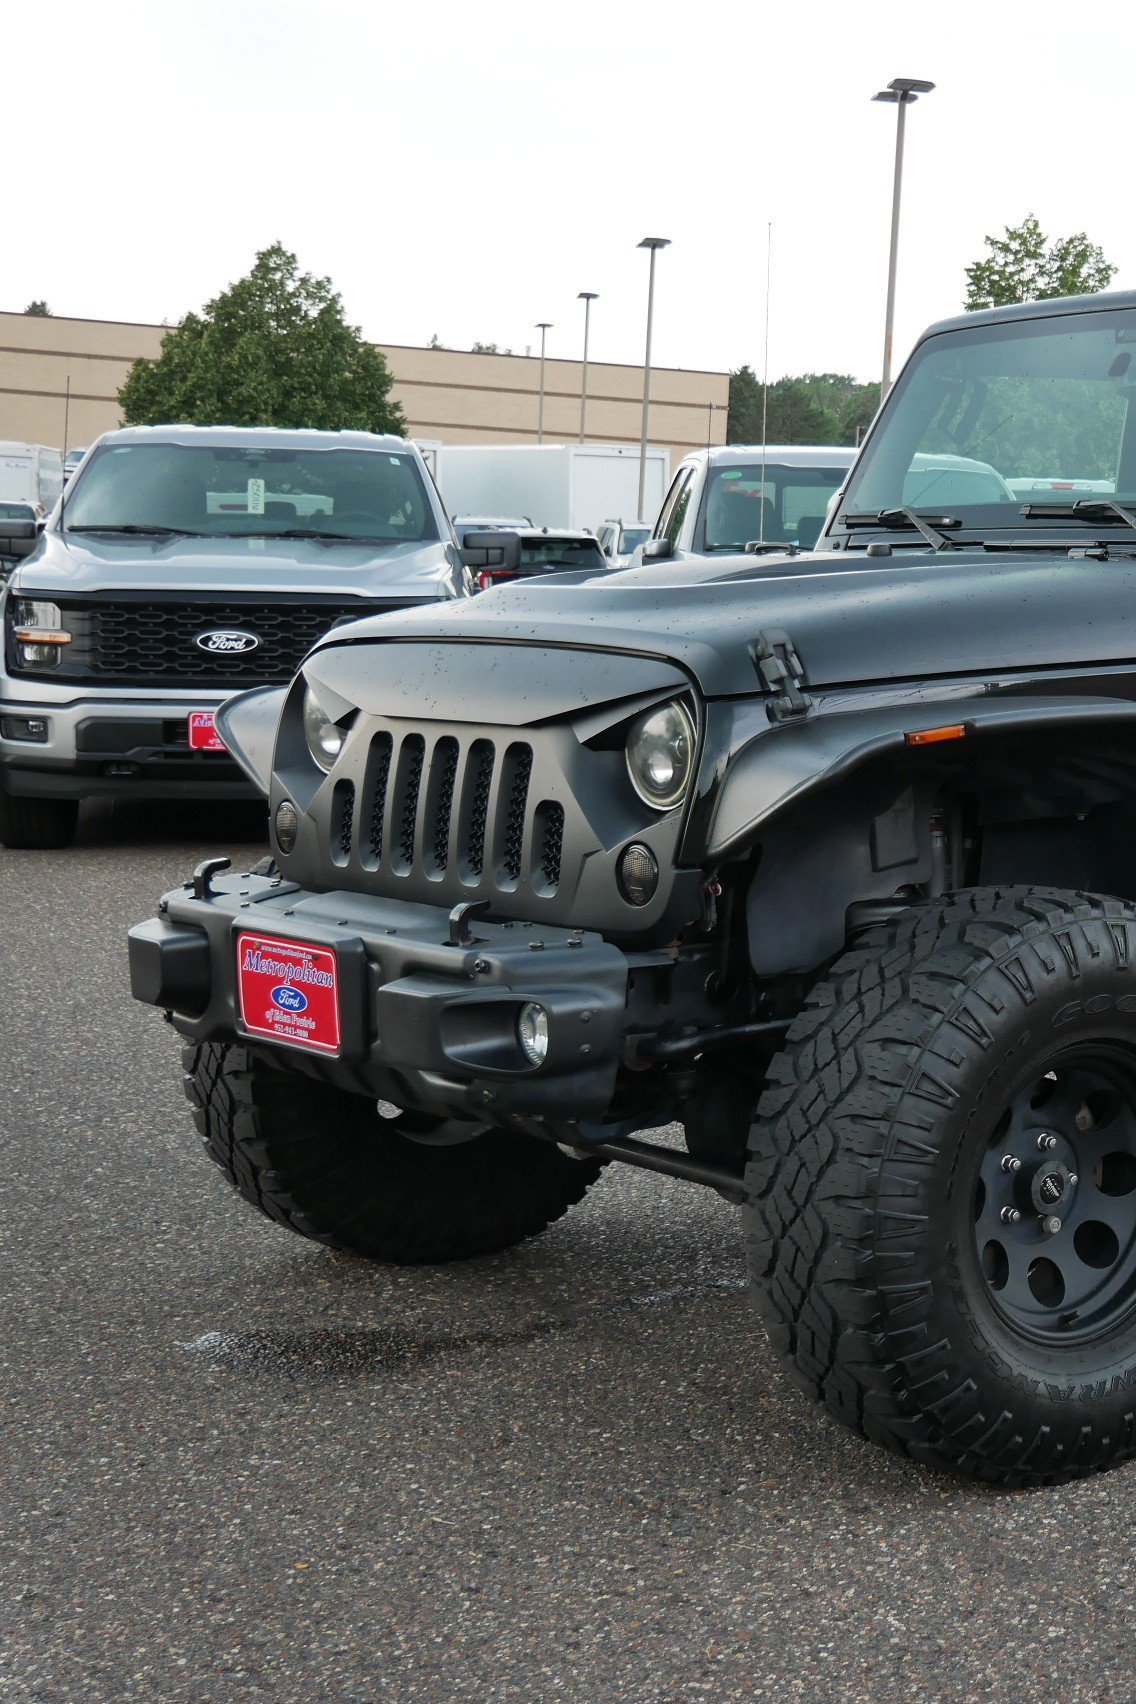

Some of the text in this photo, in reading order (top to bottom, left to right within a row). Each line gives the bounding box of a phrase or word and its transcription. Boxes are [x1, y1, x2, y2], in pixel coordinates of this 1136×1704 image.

[208, 633, 247, 650] Ford
[243, 949, 334, 989] Metropolitan
[278, 989, 300, 1008] Ford
